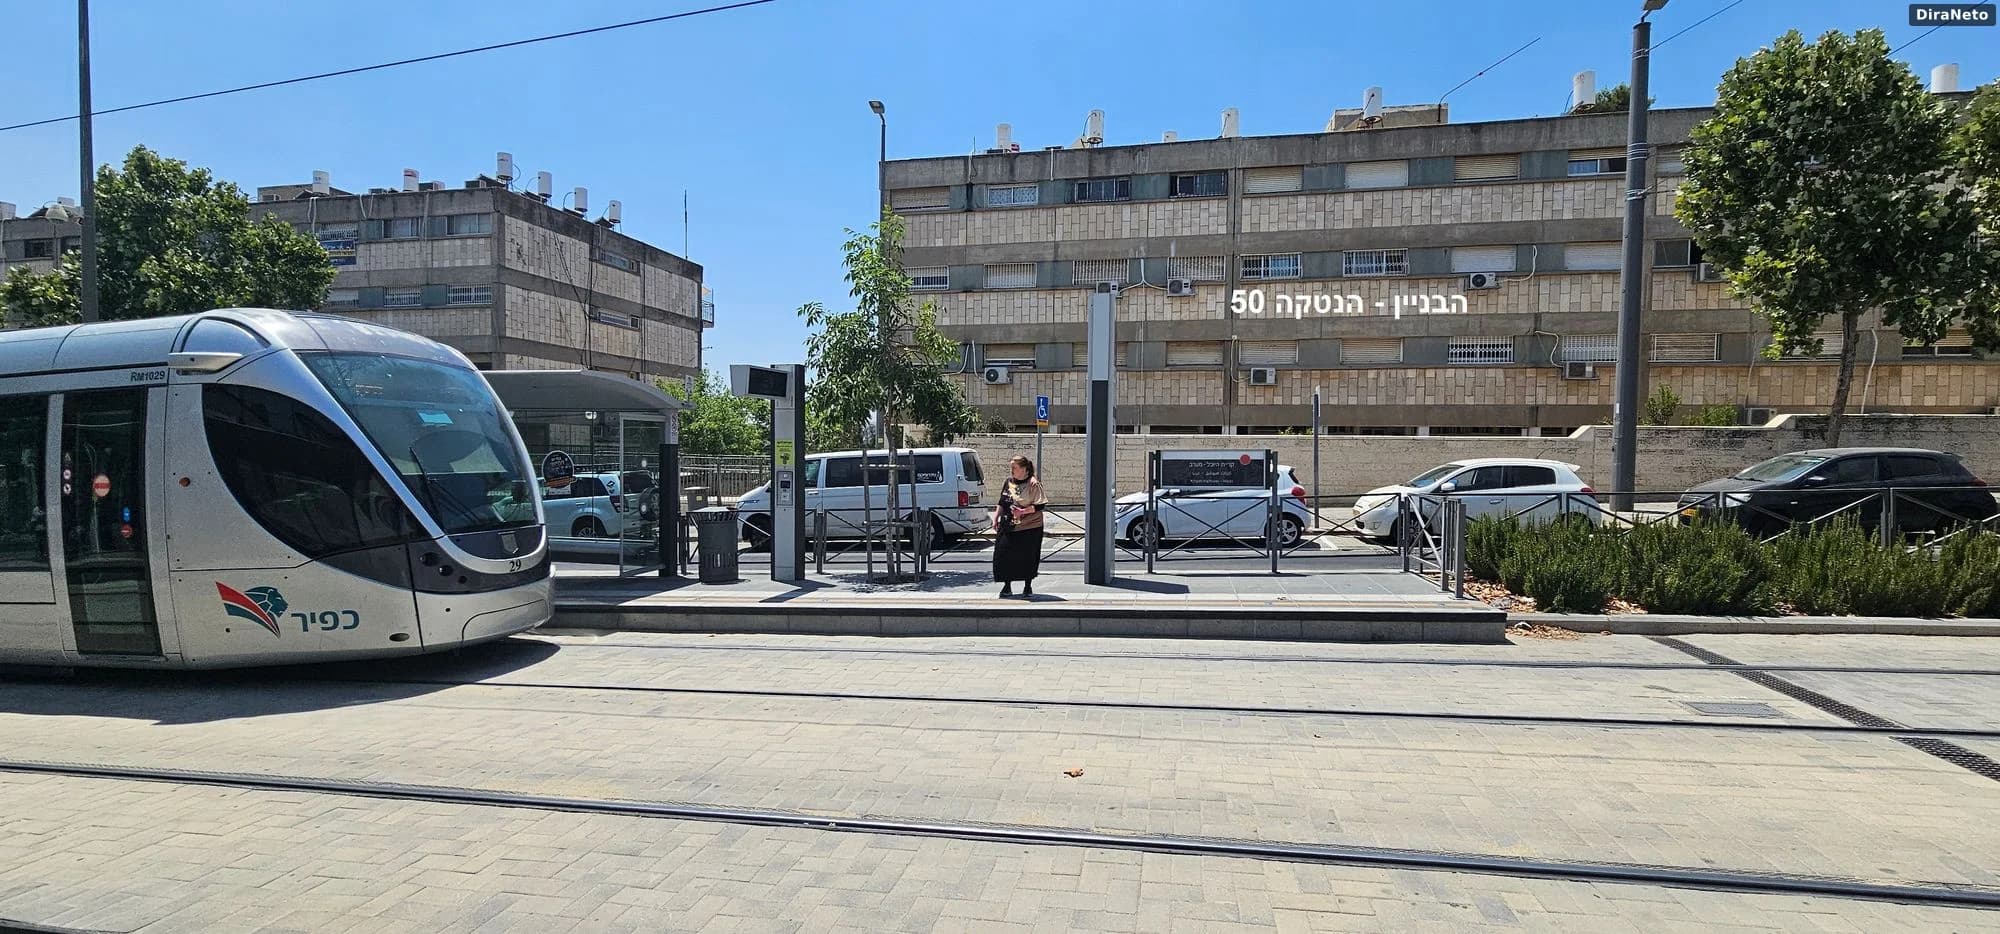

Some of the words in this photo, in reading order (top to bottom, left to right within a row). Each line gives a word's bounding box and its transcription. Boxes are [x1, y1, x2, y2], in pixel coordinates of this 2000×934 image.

[130, 370, 165, 381] RM1029
[509, 559, 521, 572] 29
[291, 610, 360, 632] כפיר
